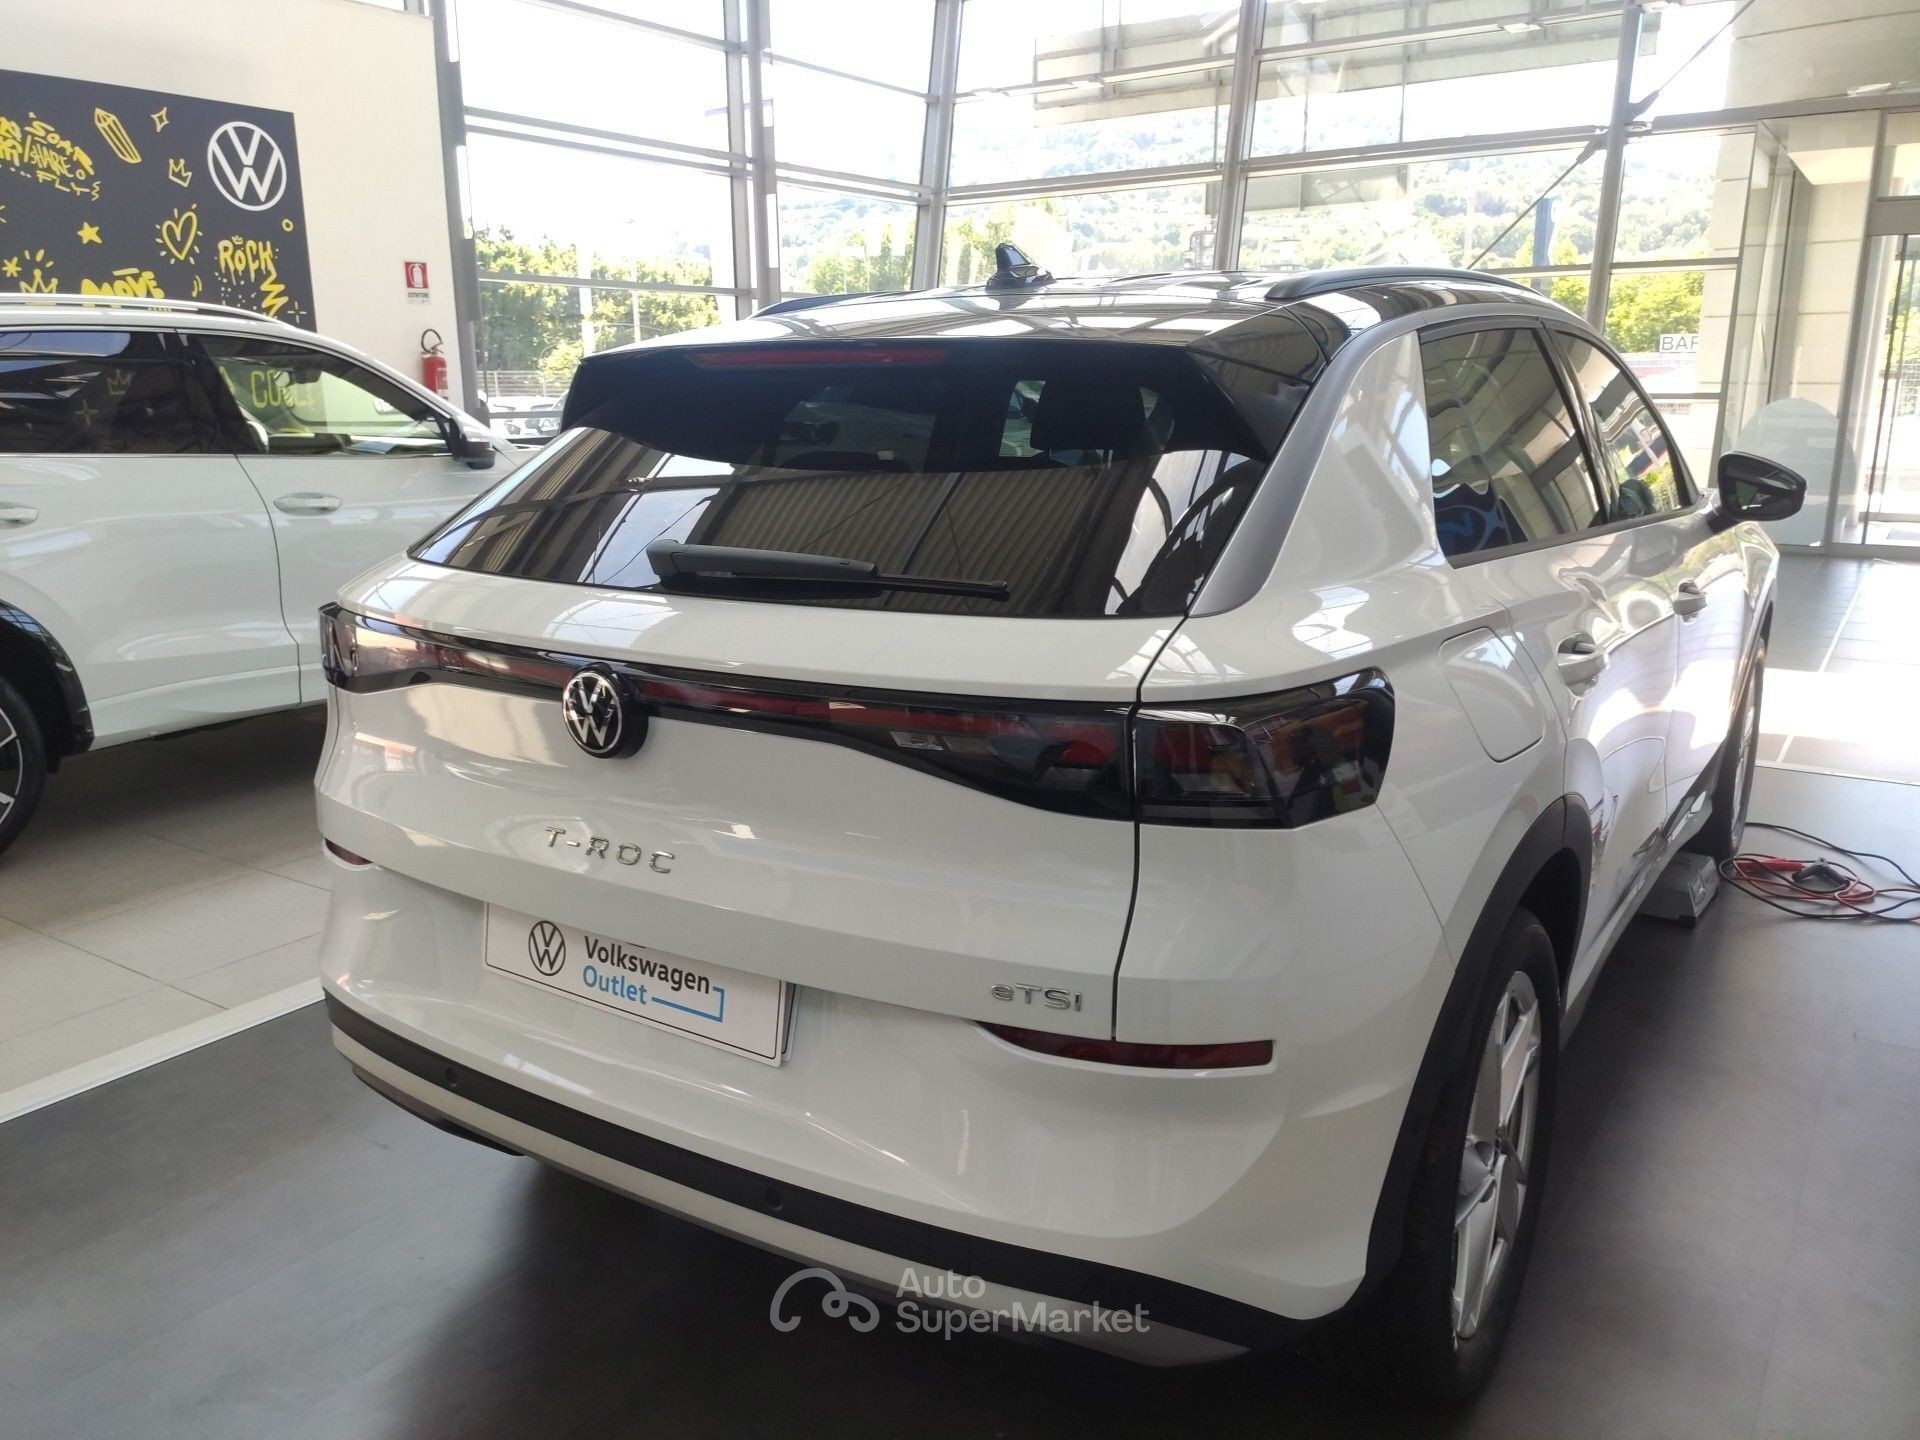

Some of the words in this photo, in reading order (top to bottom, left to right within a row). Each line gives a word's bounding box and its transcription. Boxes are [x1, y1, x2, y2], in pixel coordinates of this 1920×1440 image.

[544, 825, 676, 875] T-ROC
[582, 965, 648, 1006] Outlet
[584, 935, 710, 994] Volkswagen
